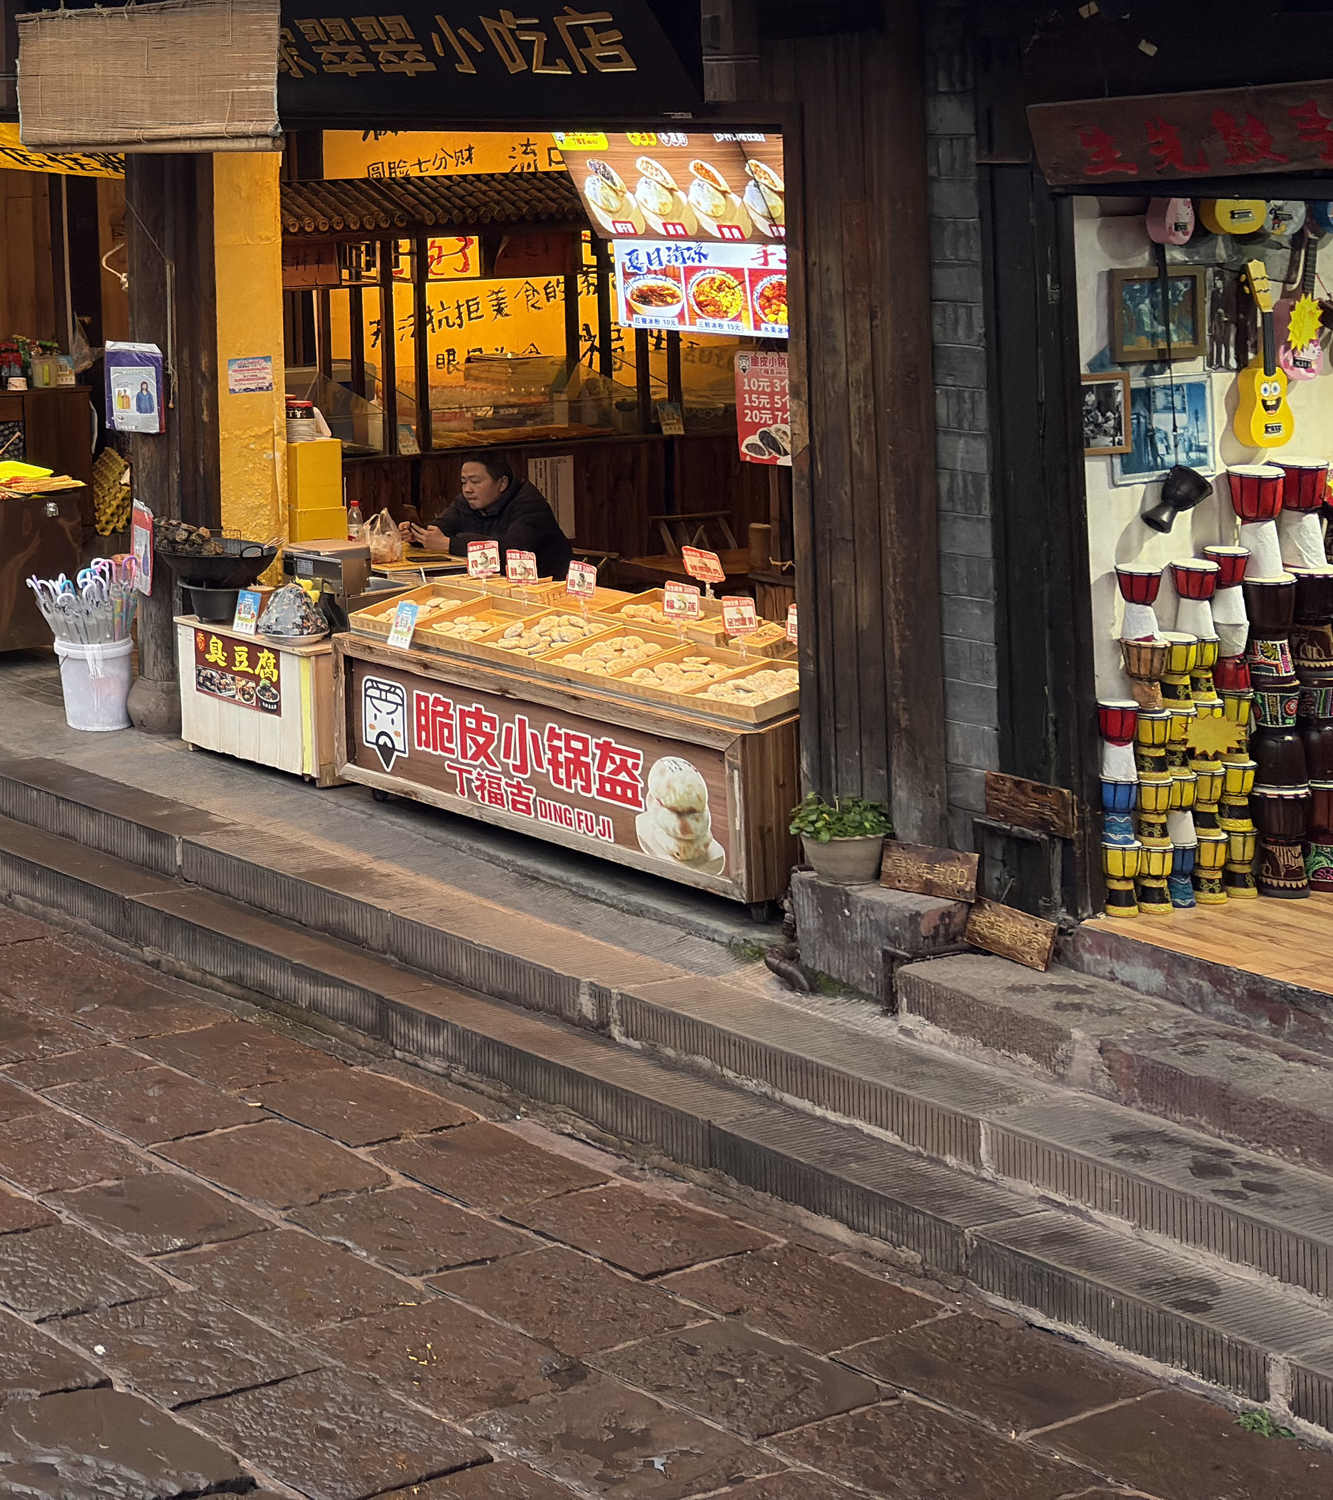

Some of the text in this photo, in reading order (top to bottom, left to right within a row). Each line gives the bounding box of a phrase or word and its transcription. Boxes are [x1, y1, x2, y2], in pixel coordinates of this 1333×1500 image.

[624, 242, 709, 271] 夏日清凉
[663, 318, 677, 327] 10元
[727, 322, 741, 332] 15元
[751, 356, 789, 368] 脆皮小锅
[743, 378, 771, 392] 10元
[744, 394, 771, 408] 15元
[744, 410, 773, 424] 20元
[204, 634, 279, 683] 臭豆腐
[415, 690, 643, 809] 脆皮小锅盔
[446, 762, 536, 816] 丁福吉
[539, 800, 612, 840] DING FU JI
